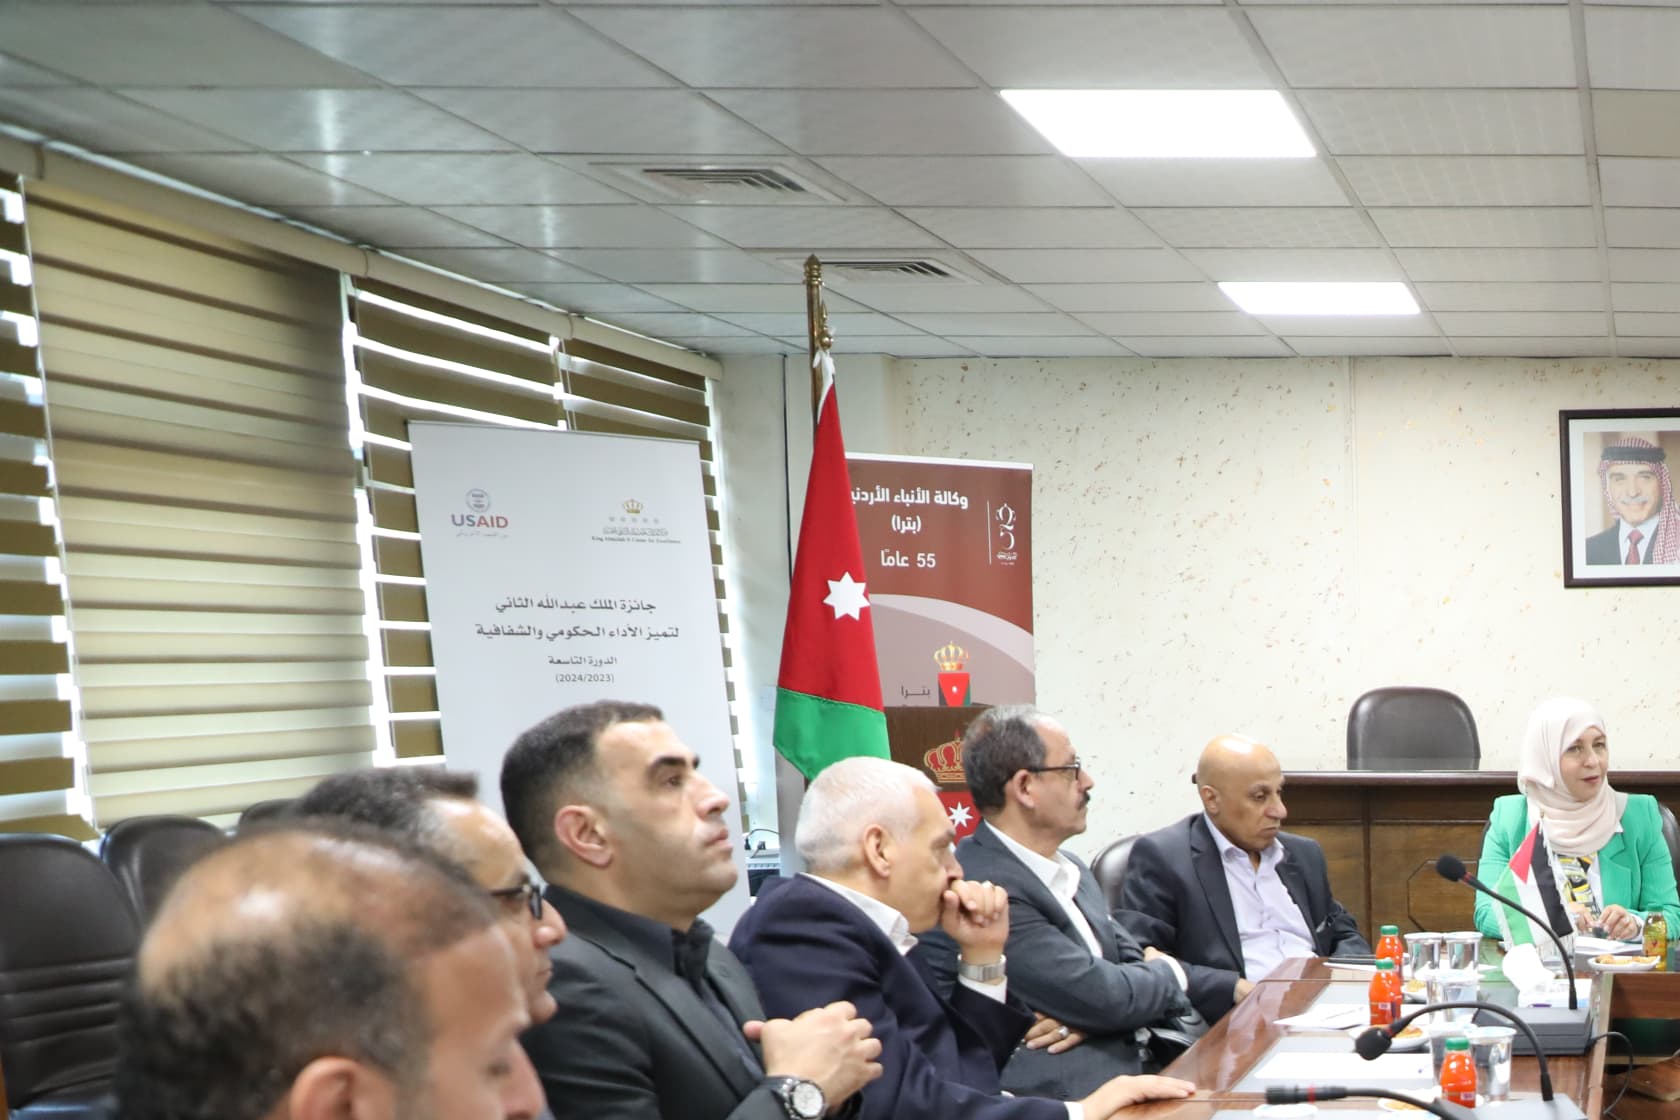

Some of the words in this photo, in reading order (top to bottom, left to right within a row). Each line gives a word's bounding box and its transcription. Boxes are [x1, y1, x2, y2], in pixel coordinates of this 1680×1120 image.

[851, 485, 890, 505] الأردني
[893, 487, 930, 507] الأنباء
[934, 490, 969, 510] وكالة
[451, 513, 509, 529] USAID
[891, 514, 922, 534] (بترا)
[916, 553, 936, 568] 55
[495, 596, 533, 613] الثاني
[590, 598, 617, 610] الملك
[620, 599, 656, 614] جائزة
[475, 624, 543, 640] والشفافية
[546, 625, 605, 642] الحكومي
[646, 626, 679, 640] لتميز
[548, 655, 586, 665] التاسعة
[588, 656, 617, 667] الدورة
[555, 673, 614, 683] (2024/2023)
